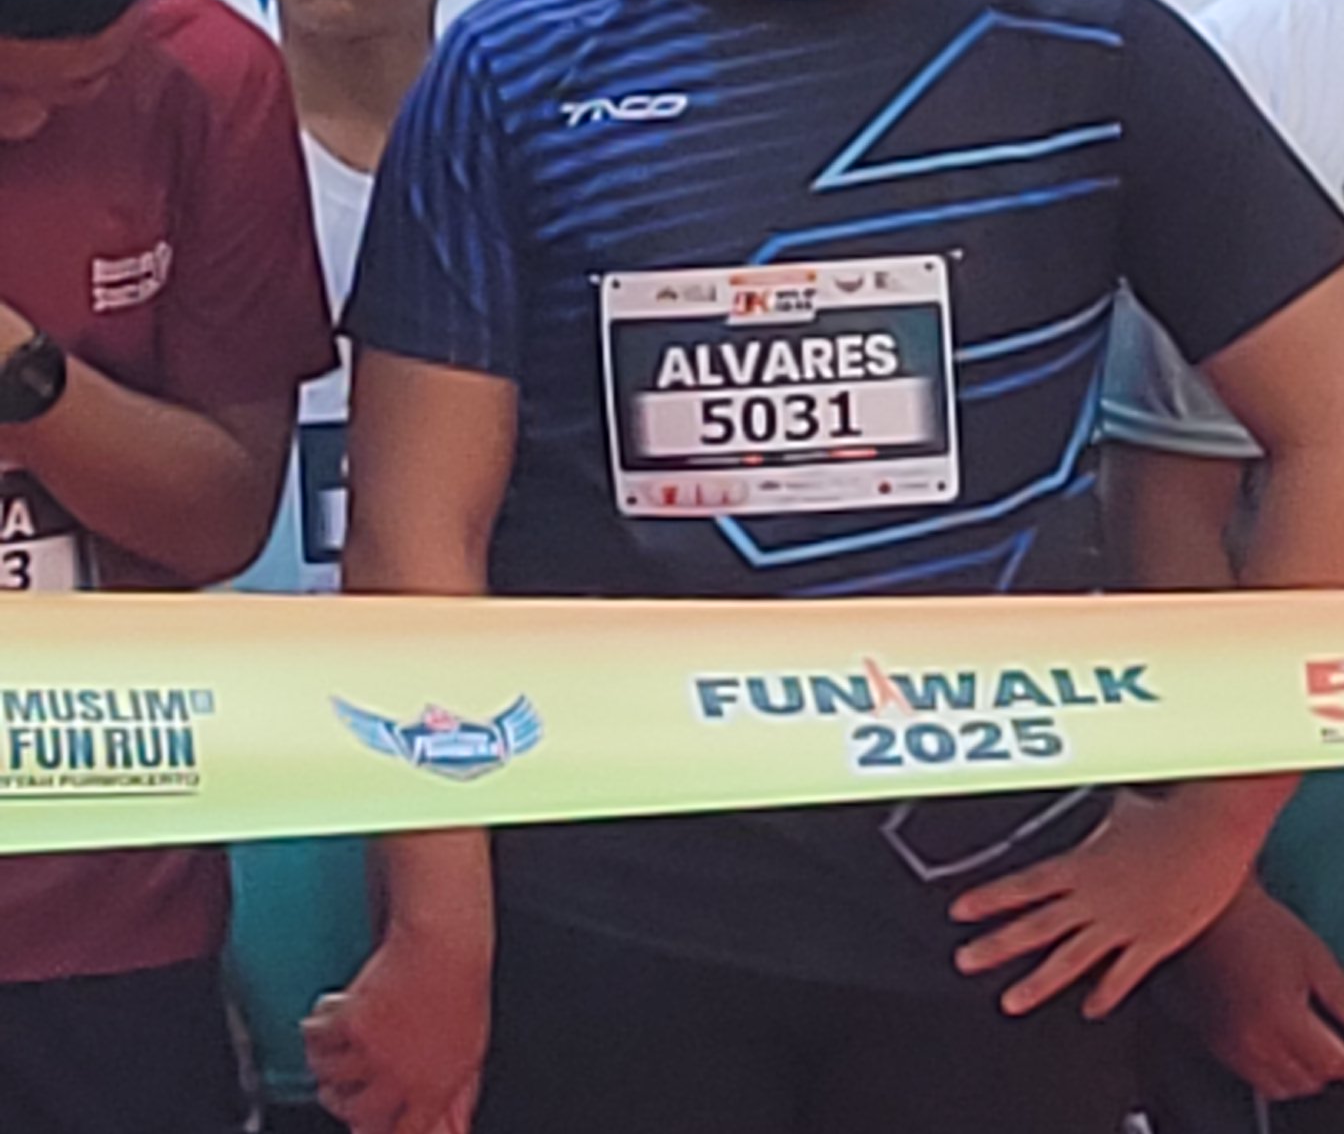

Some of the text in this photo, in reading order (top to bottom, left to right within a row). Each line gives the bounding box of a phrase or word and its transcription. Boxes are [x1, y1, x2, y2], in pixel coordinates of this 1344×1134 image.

[656, 334, 898, 390] ALVARES
[699, 390, 863, 446] 5031
[0, 496, 35, 540] A
[2, 688, 190, 723] MUSLIM
[694, 665, 1161, 718] FUN WALK
[9, 725, 197, 771] FUN RUN
[851, 717, 1065, 768] 2025
